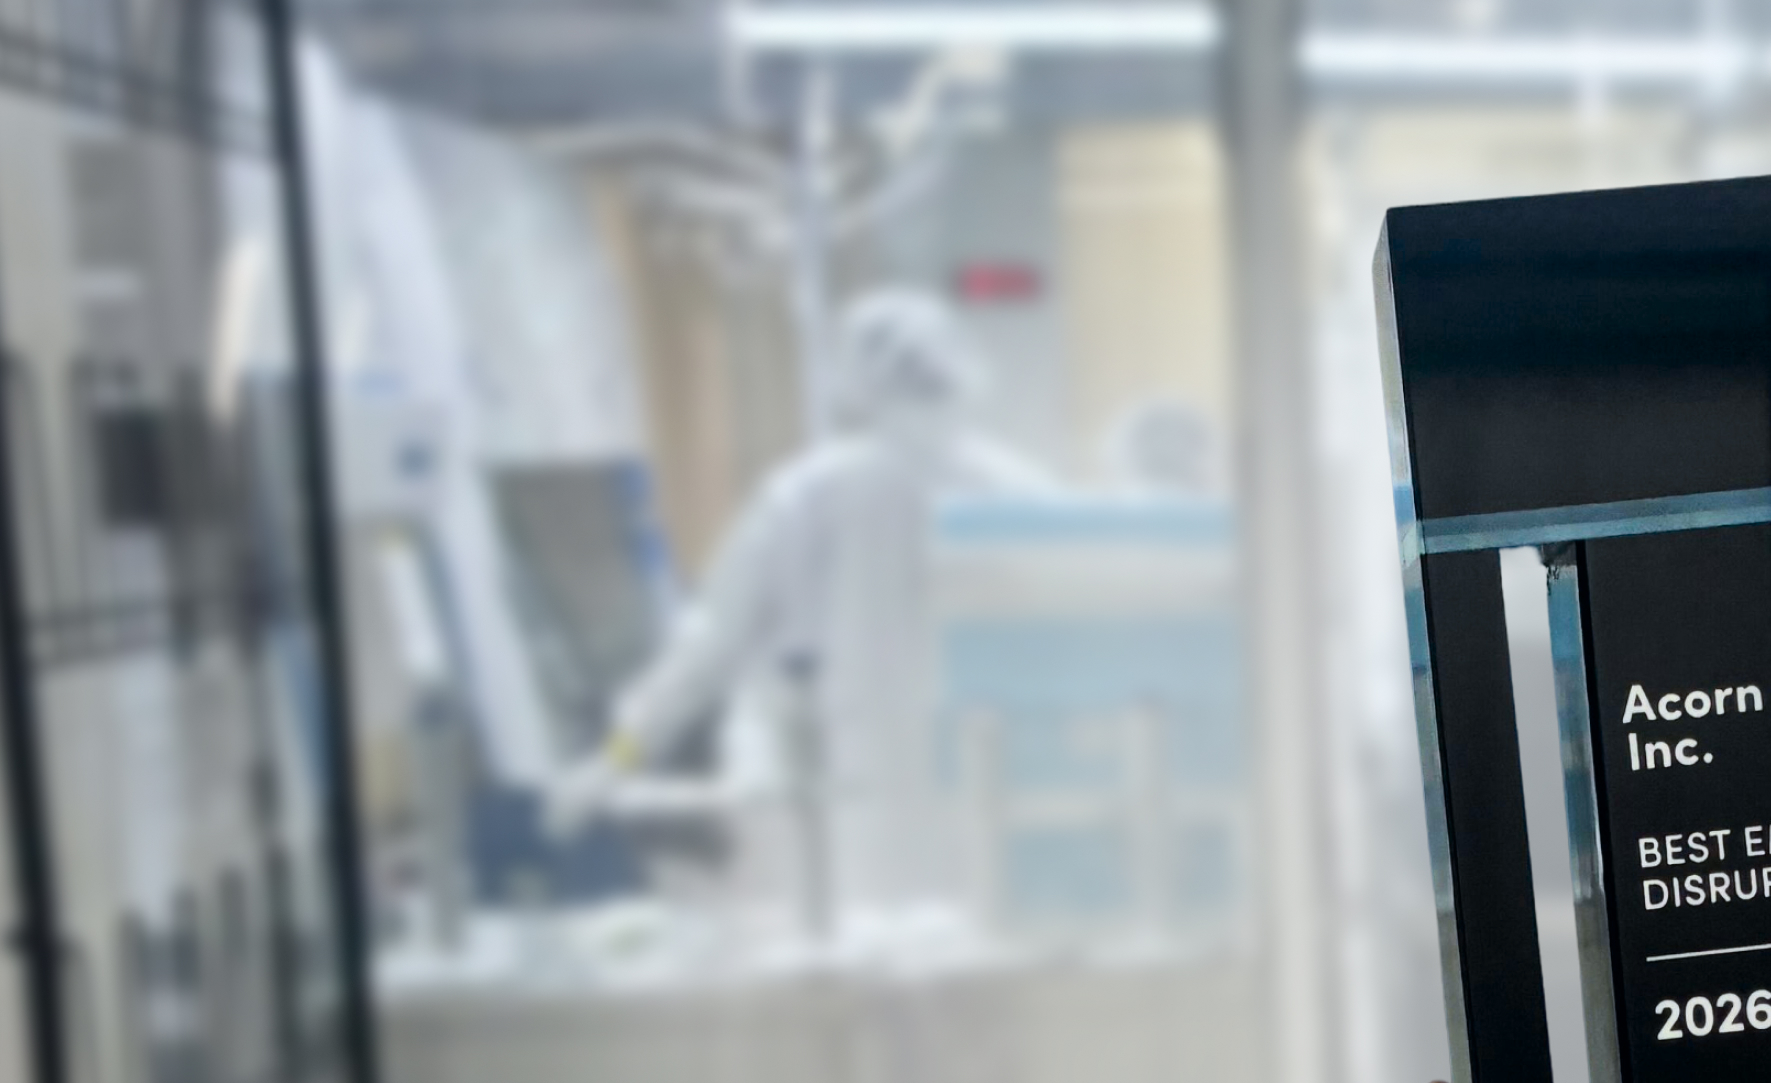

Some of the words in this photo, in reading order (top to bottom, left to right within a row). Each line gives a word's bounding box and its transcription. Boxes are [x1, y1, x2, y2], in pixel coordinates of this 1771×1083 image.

[1622, 684, 1764, 724] Acorn
[1628, 732, 1713, 771] Inc.
[1638, 829, 1731, 868] BEST
